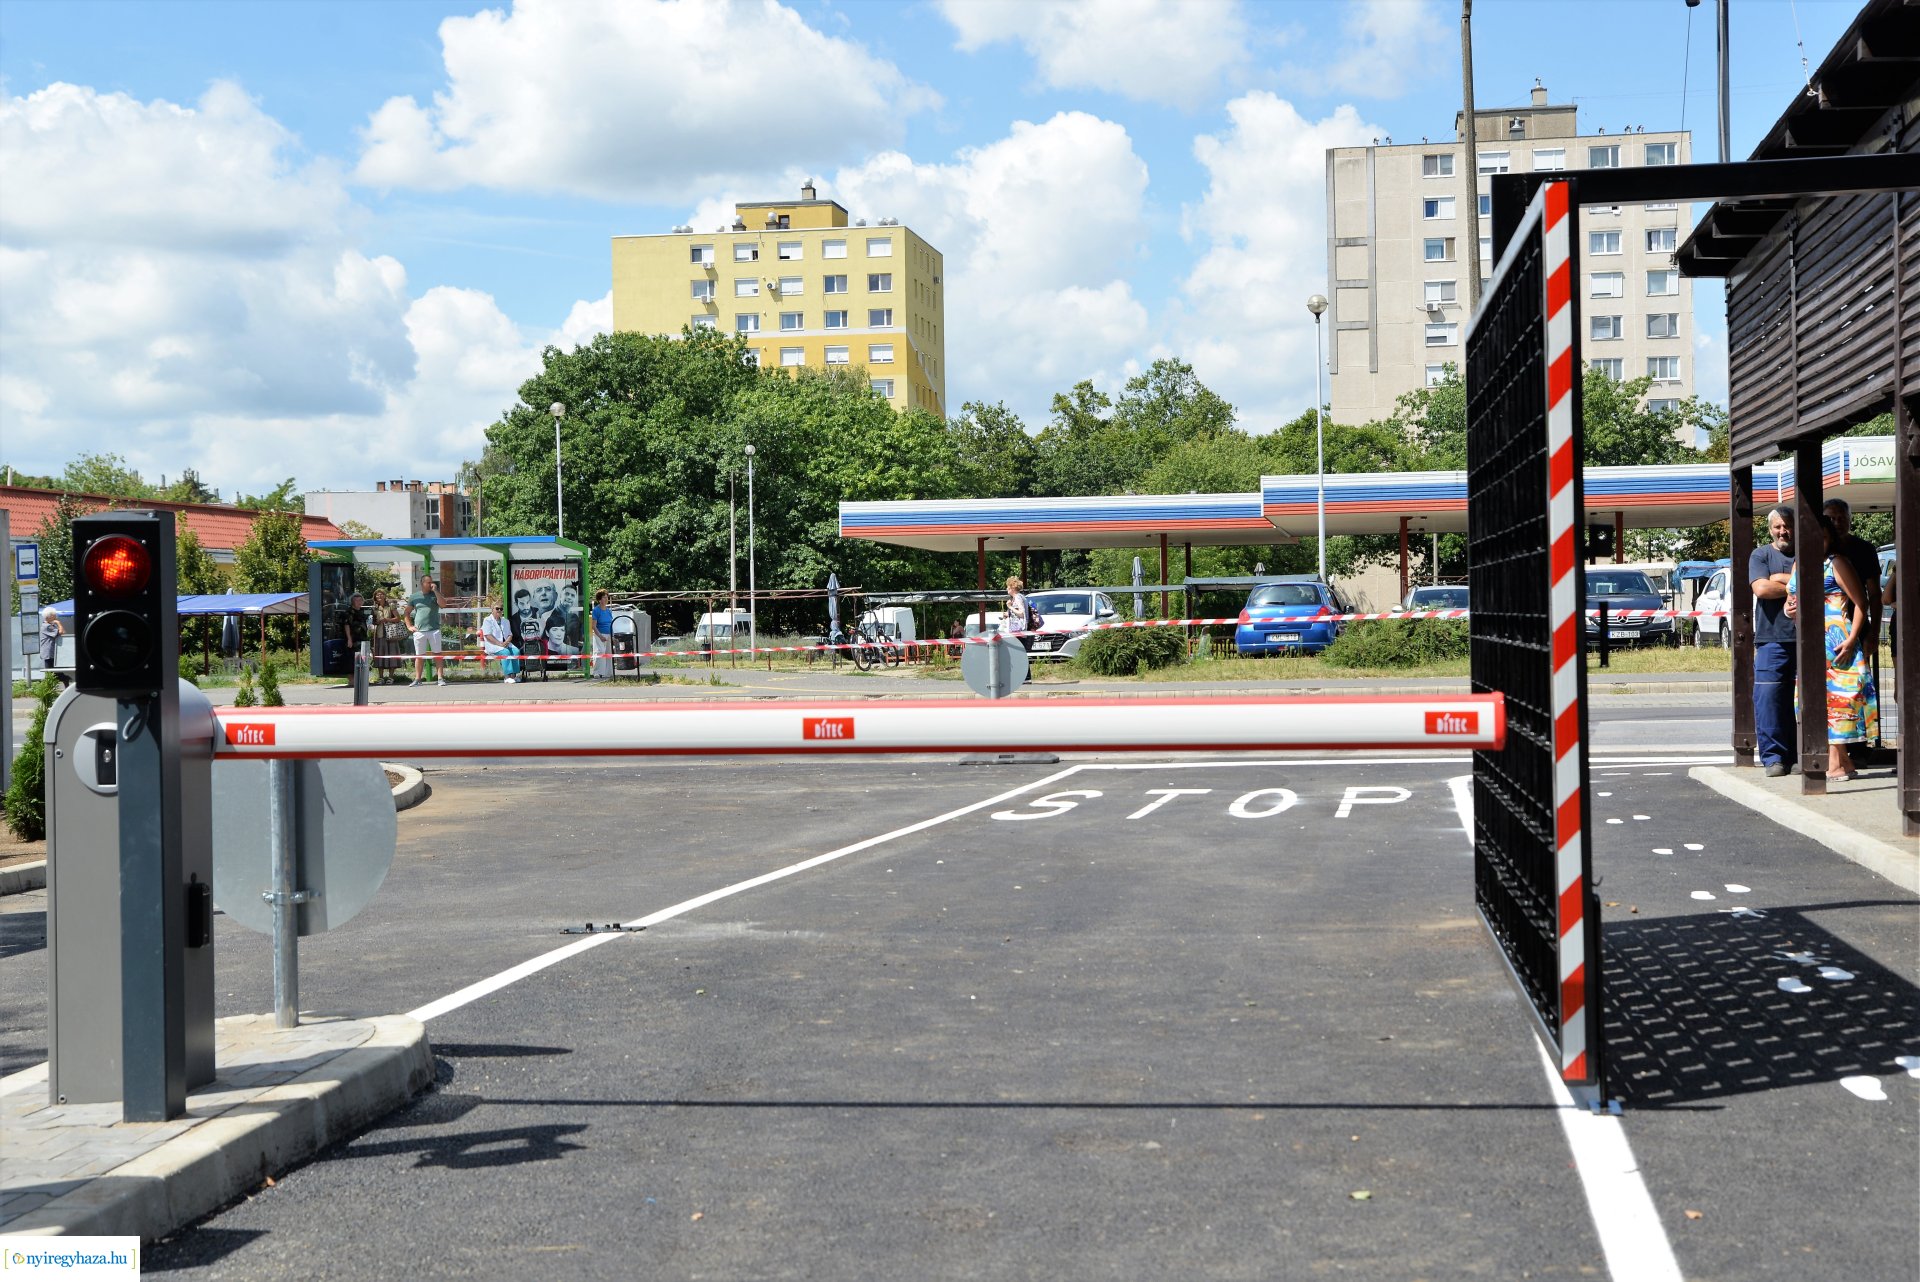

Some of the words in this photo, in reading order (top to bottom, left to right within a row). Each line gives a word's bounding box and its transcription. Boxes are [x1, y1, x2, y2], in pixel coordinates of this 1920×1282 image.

[1854, 454, 1897, 467] JÓSAV
[513, 566, 577, 580] HÁBORÚPÁRTIAK
[990, 786, 1413, 821] STOP
